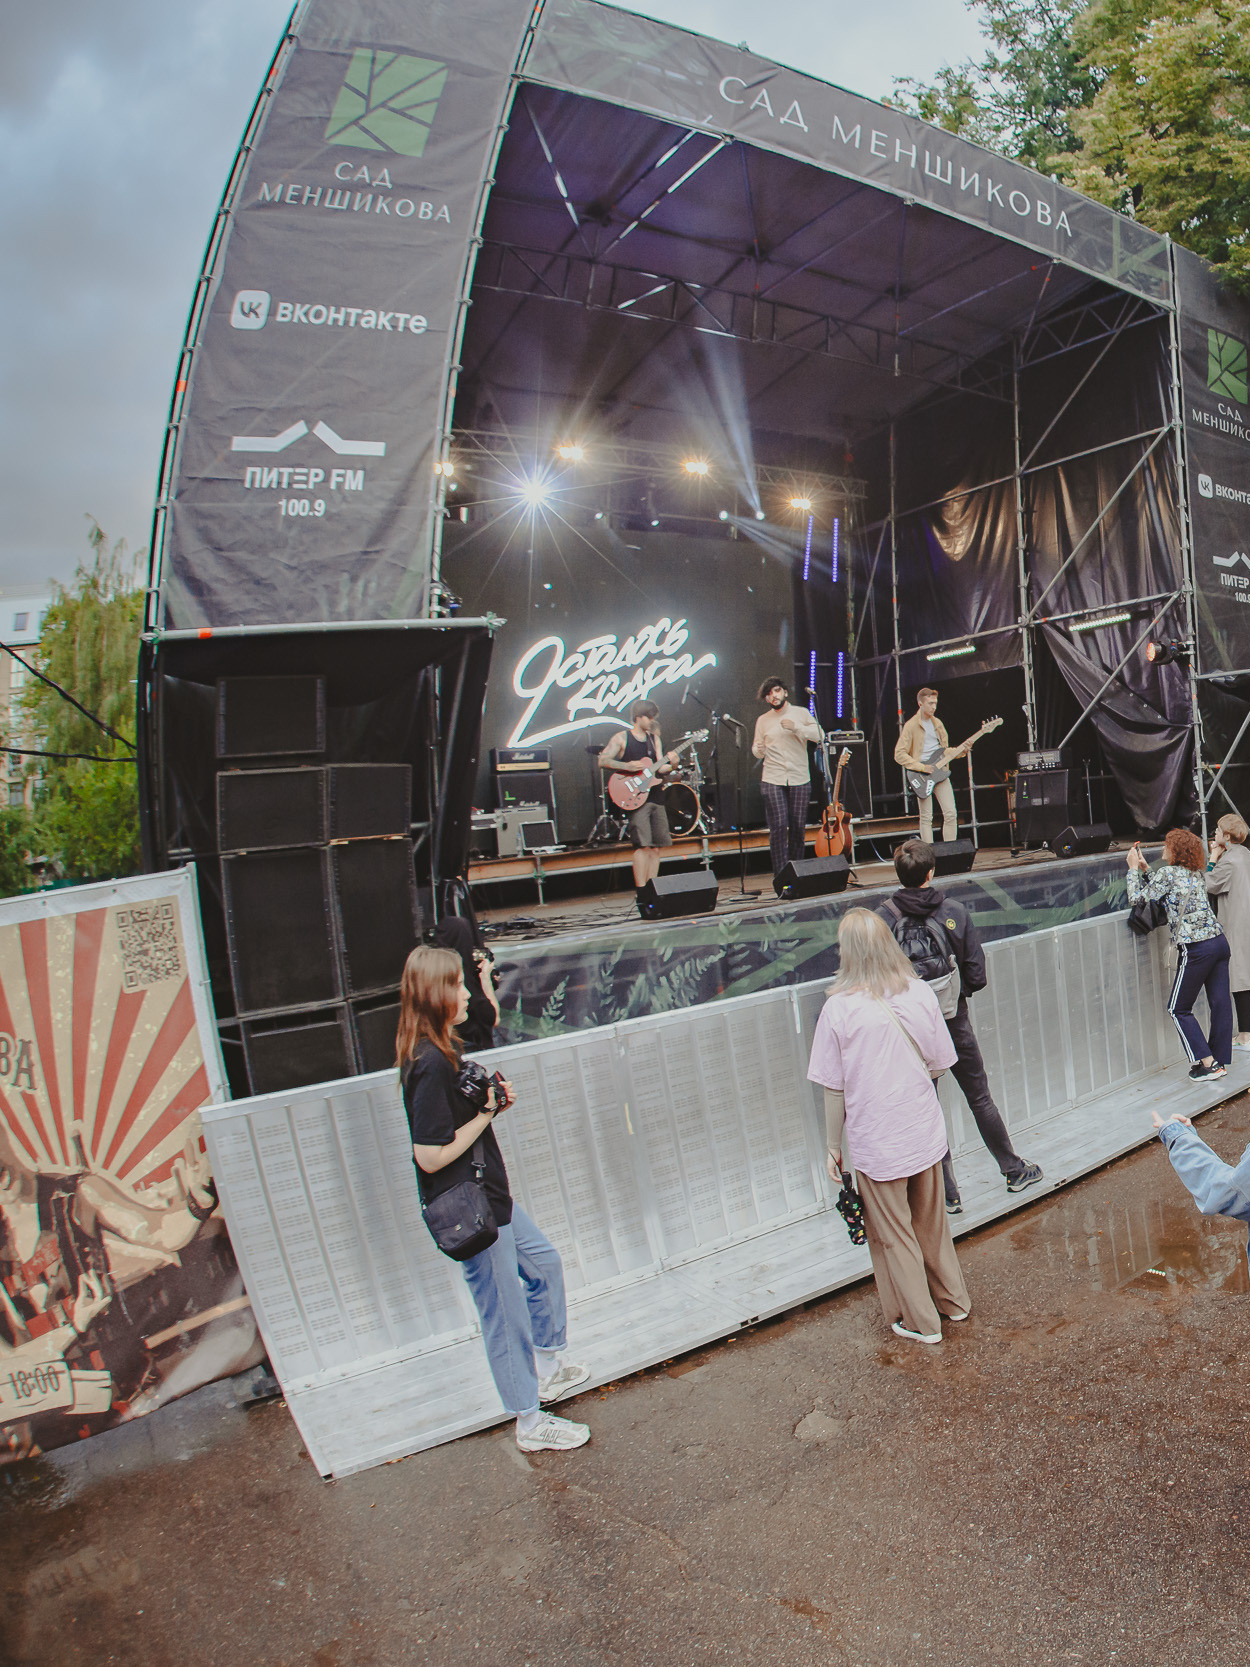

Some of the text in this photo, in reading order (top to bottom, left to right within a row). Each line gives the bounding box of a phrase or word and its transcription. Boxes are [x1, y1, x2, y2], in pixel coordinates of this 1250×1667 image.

[718, 76, 1073, 237] САД МЕНШИКОВА
[334, 161, 394, 190] САД
[257, 182, 452, 224] МЕНШИКОВА
[1217, 402, 1244, 423] САД
[244, 466, 365, 491] ПИТЕР FM
[278, 498, 325, 517] 100.9
[1220, 572, 1250, 590] ПИТЕР
[8, 1366, 60, 1399] 18:00
